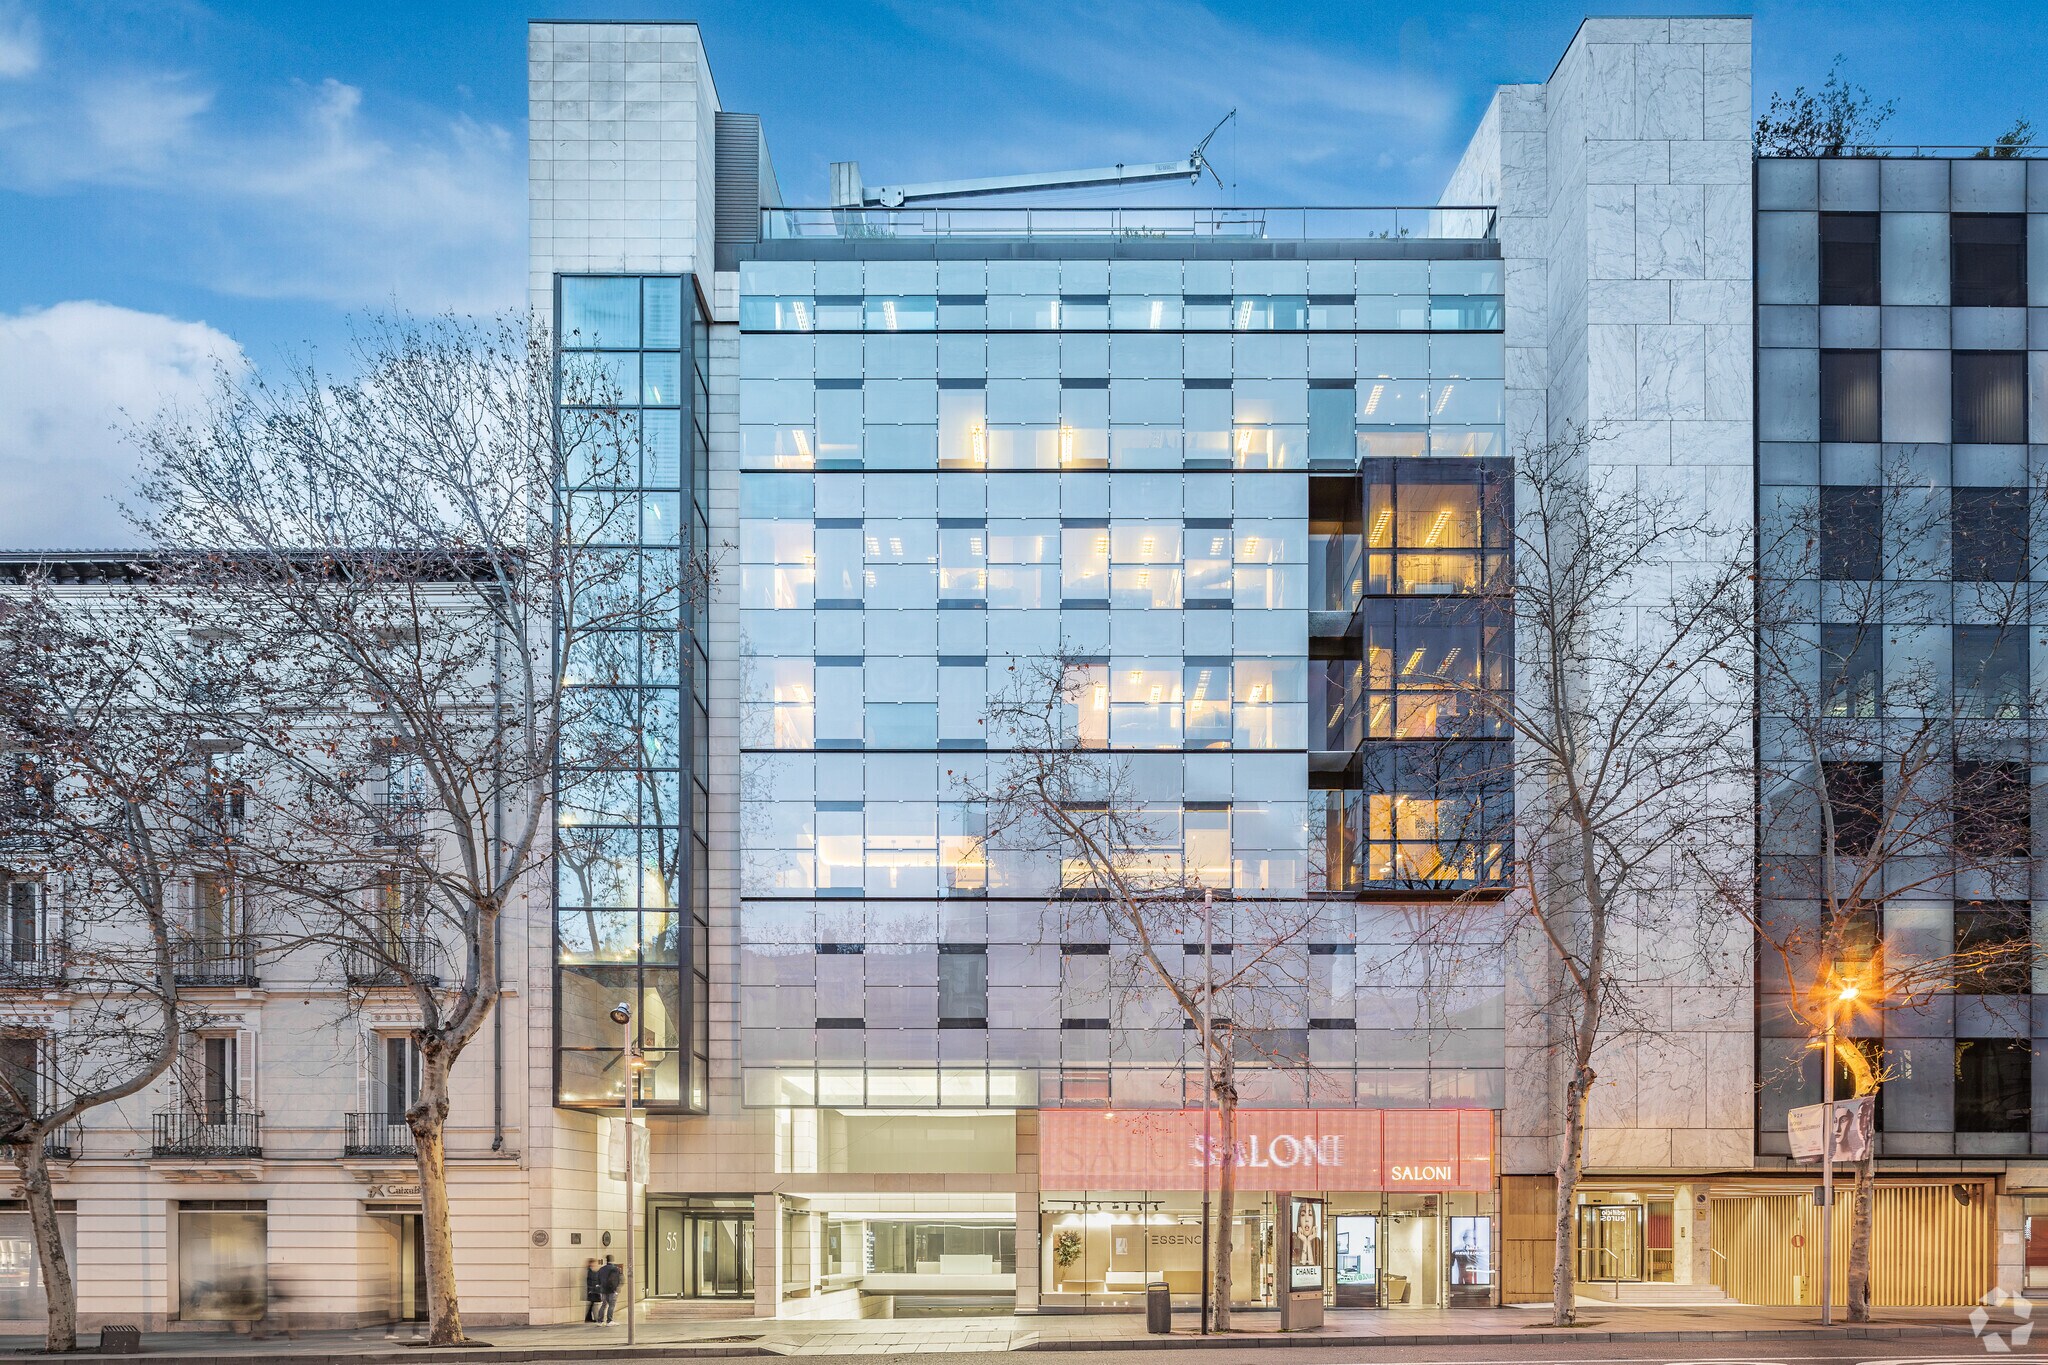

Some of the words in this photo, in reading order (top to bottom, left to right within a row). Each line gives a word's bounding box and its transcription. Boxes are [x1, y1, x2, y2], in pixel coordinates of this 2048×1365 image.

[1391, 1165, 1452, 1181] SALONI
[387, 1185, 421, 1195] CaixaB
[666, 1231, 678, 1251] 55
[1151, 1235, 1211, 1245] ESSENC
[1295, 1267, 1317, 1276] CHANEL
